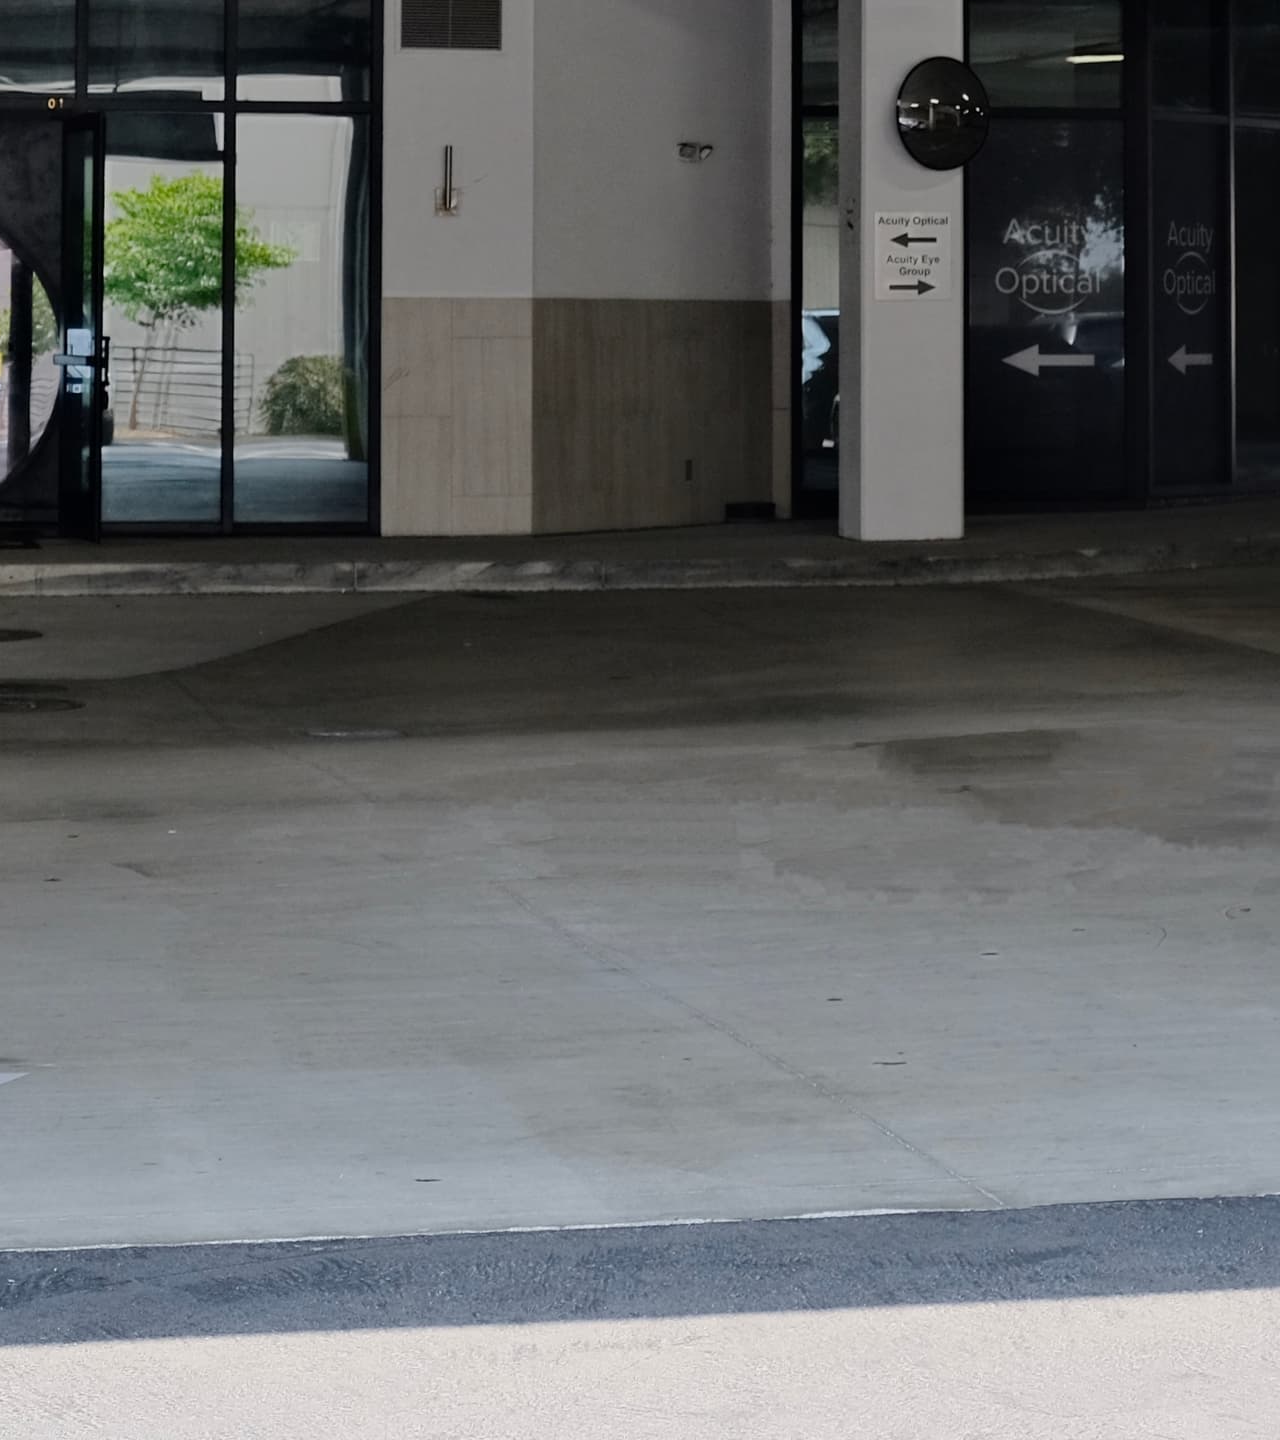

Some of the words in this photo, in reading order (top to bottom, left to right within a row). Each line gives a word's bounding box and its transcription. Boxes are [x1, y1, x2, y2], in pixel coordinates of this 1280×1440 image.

[878, 216, 910, 227] Acuity
[912, 216, 949, 227] Optical
[1167, 220, 1214, 253] Acuity
[887, 255, 919, 266] Acuity
[921, 255, 941, 265] Eye
[899, 266, 931, 278] Group
[995, 267, 1101, 300] Optical
[1163, 268, 1216, 300] Optical
